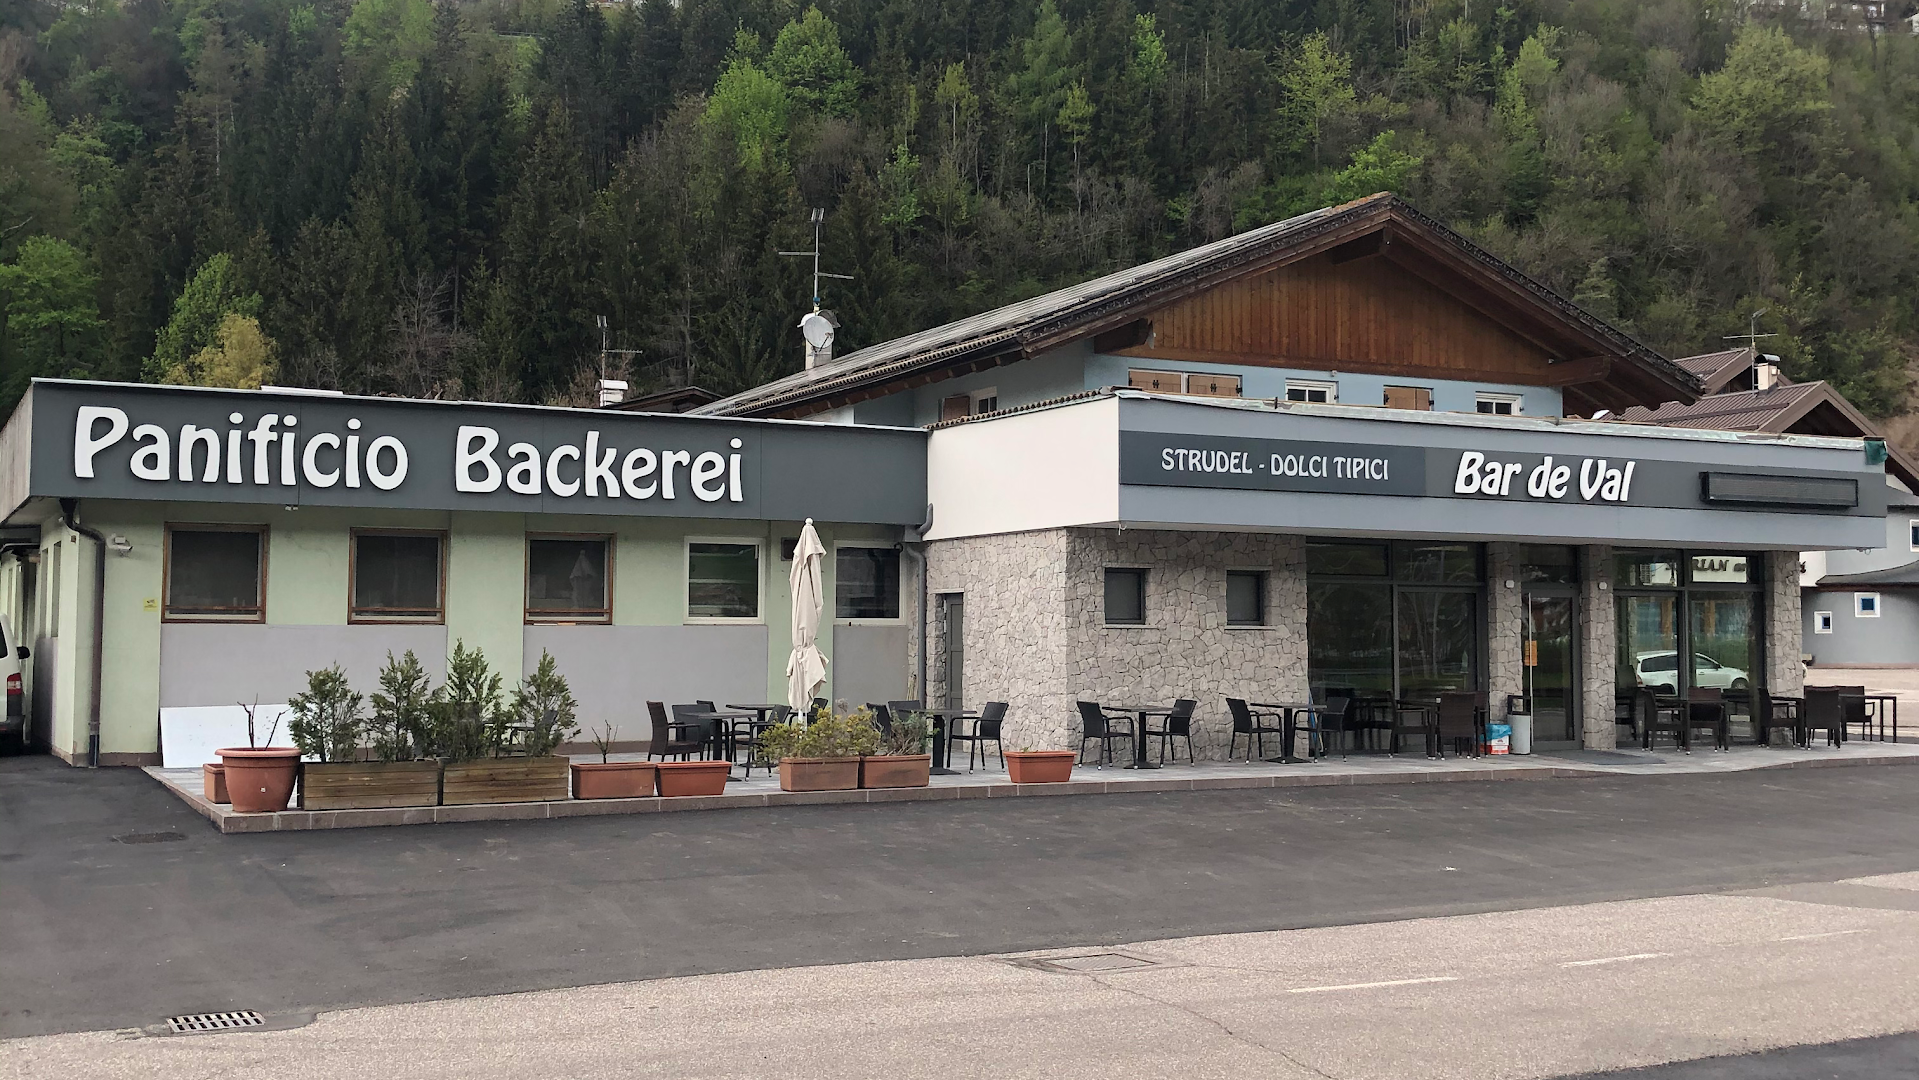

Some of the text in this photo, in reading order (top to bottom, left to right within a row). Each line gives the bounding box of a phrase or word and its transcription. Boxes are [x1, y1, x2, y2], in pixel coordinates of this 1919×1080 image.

[74, 405, 744, 503] Panificio Backerei
[1161, 447, 1254, 475] STRUDEL
[1270, 453, 1328, 479] DOLCI
[1332, 456, 1389, 481] TIPICI
[1454, 451, 1636, 502] Bar de Val
